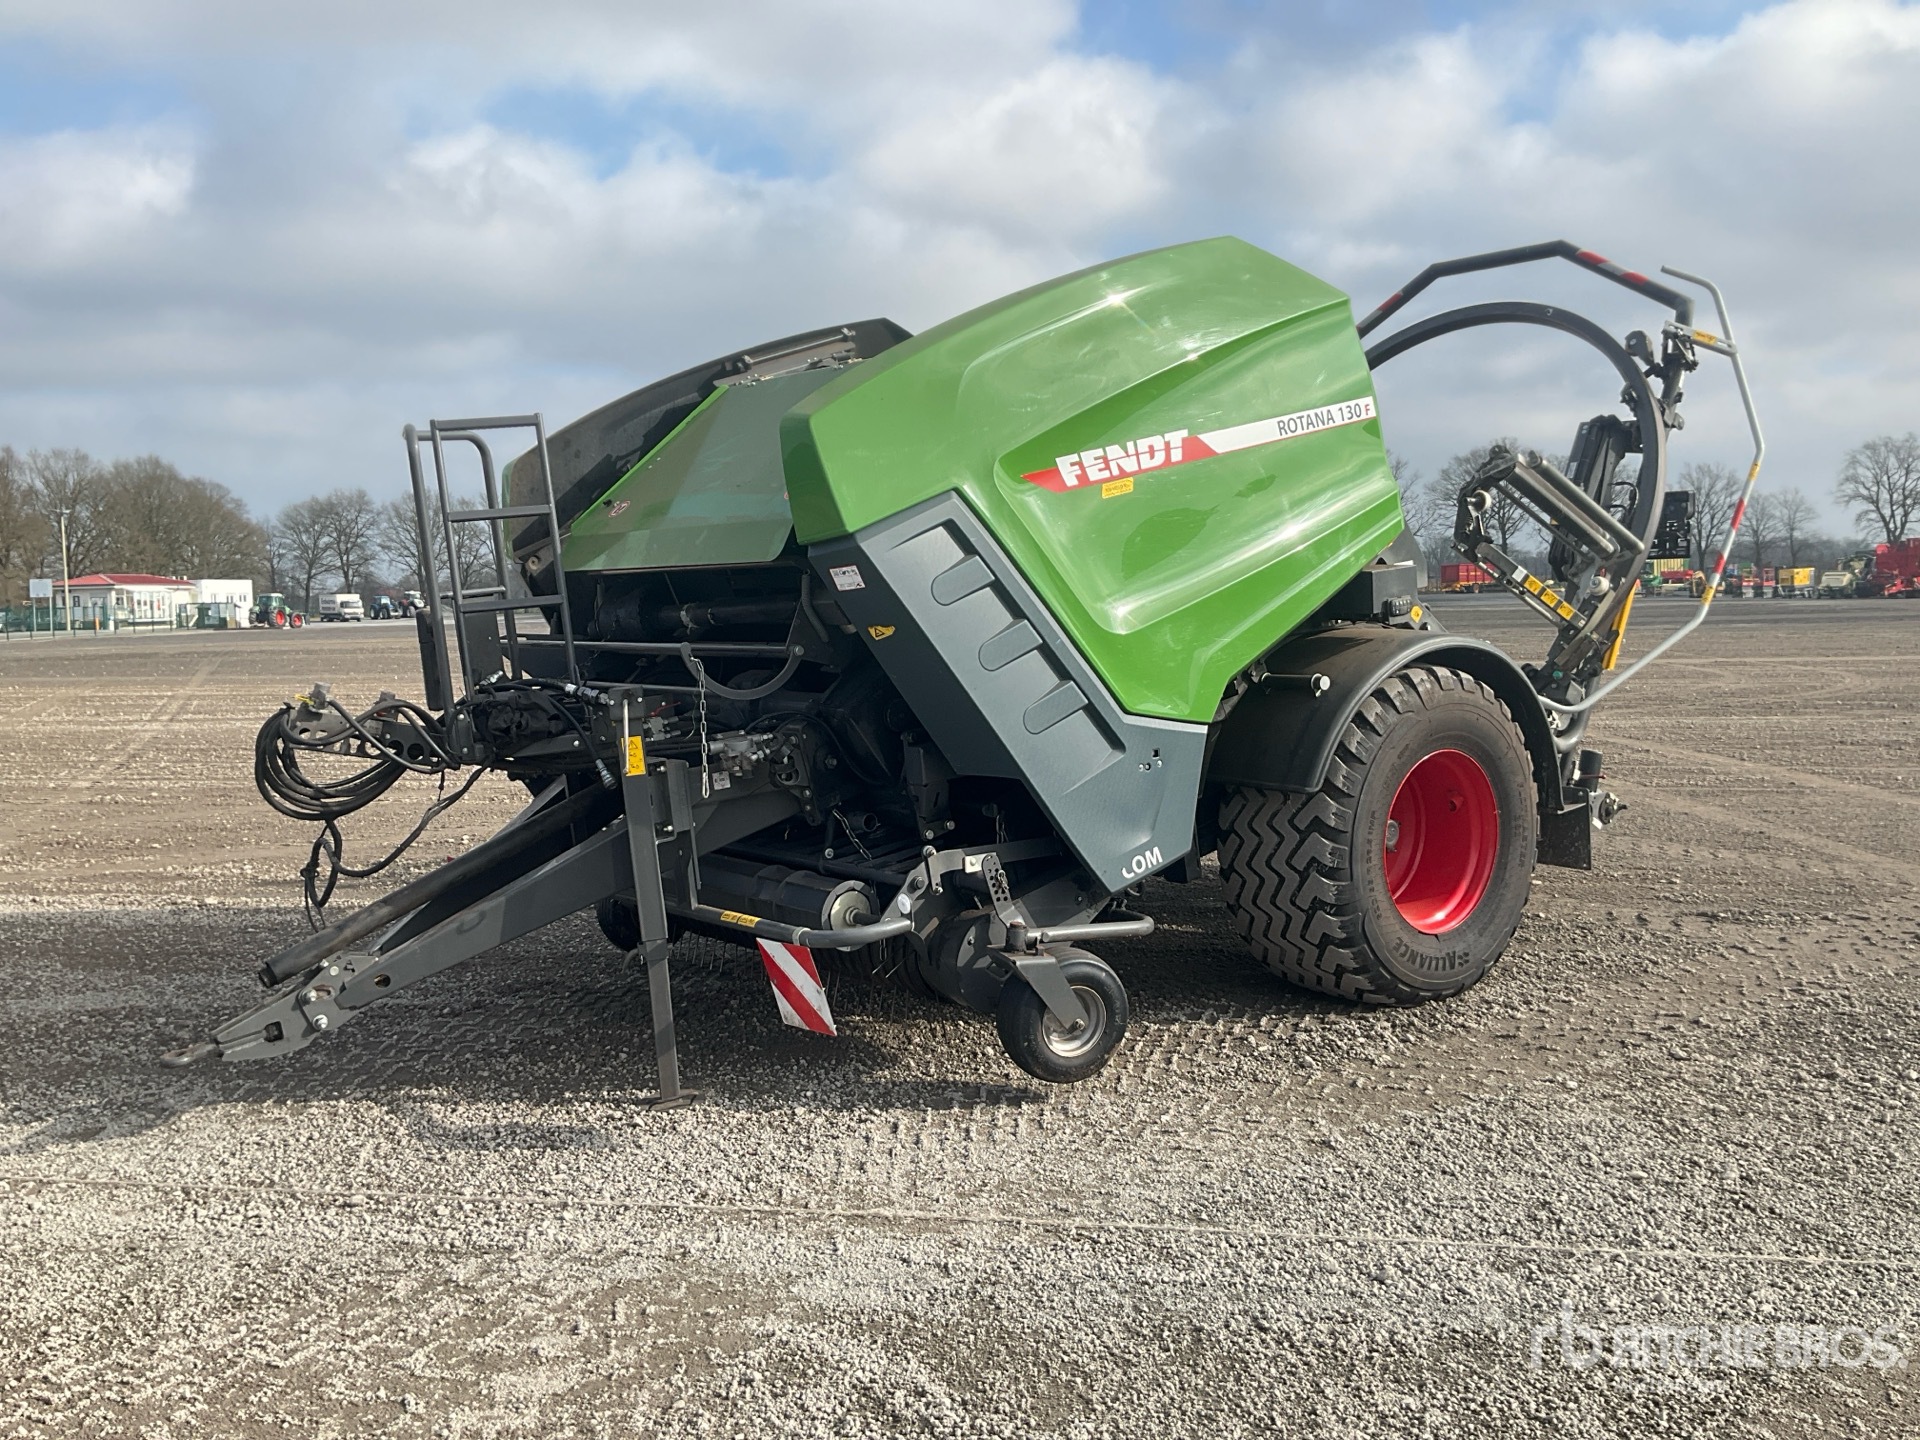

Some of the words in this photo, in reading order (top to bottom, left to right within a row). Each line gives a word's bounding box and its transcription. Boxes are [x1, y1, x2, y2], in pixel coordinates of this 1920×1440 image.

[1055, 429, 1189, 488] FENDT
[1277, 409, 1335, 437] ROTANA
[1338, 402, 1362, 422] 130
[1364, 403, 1371, 417] F
[1392, 936, 1457, 972] ALLIANCE
